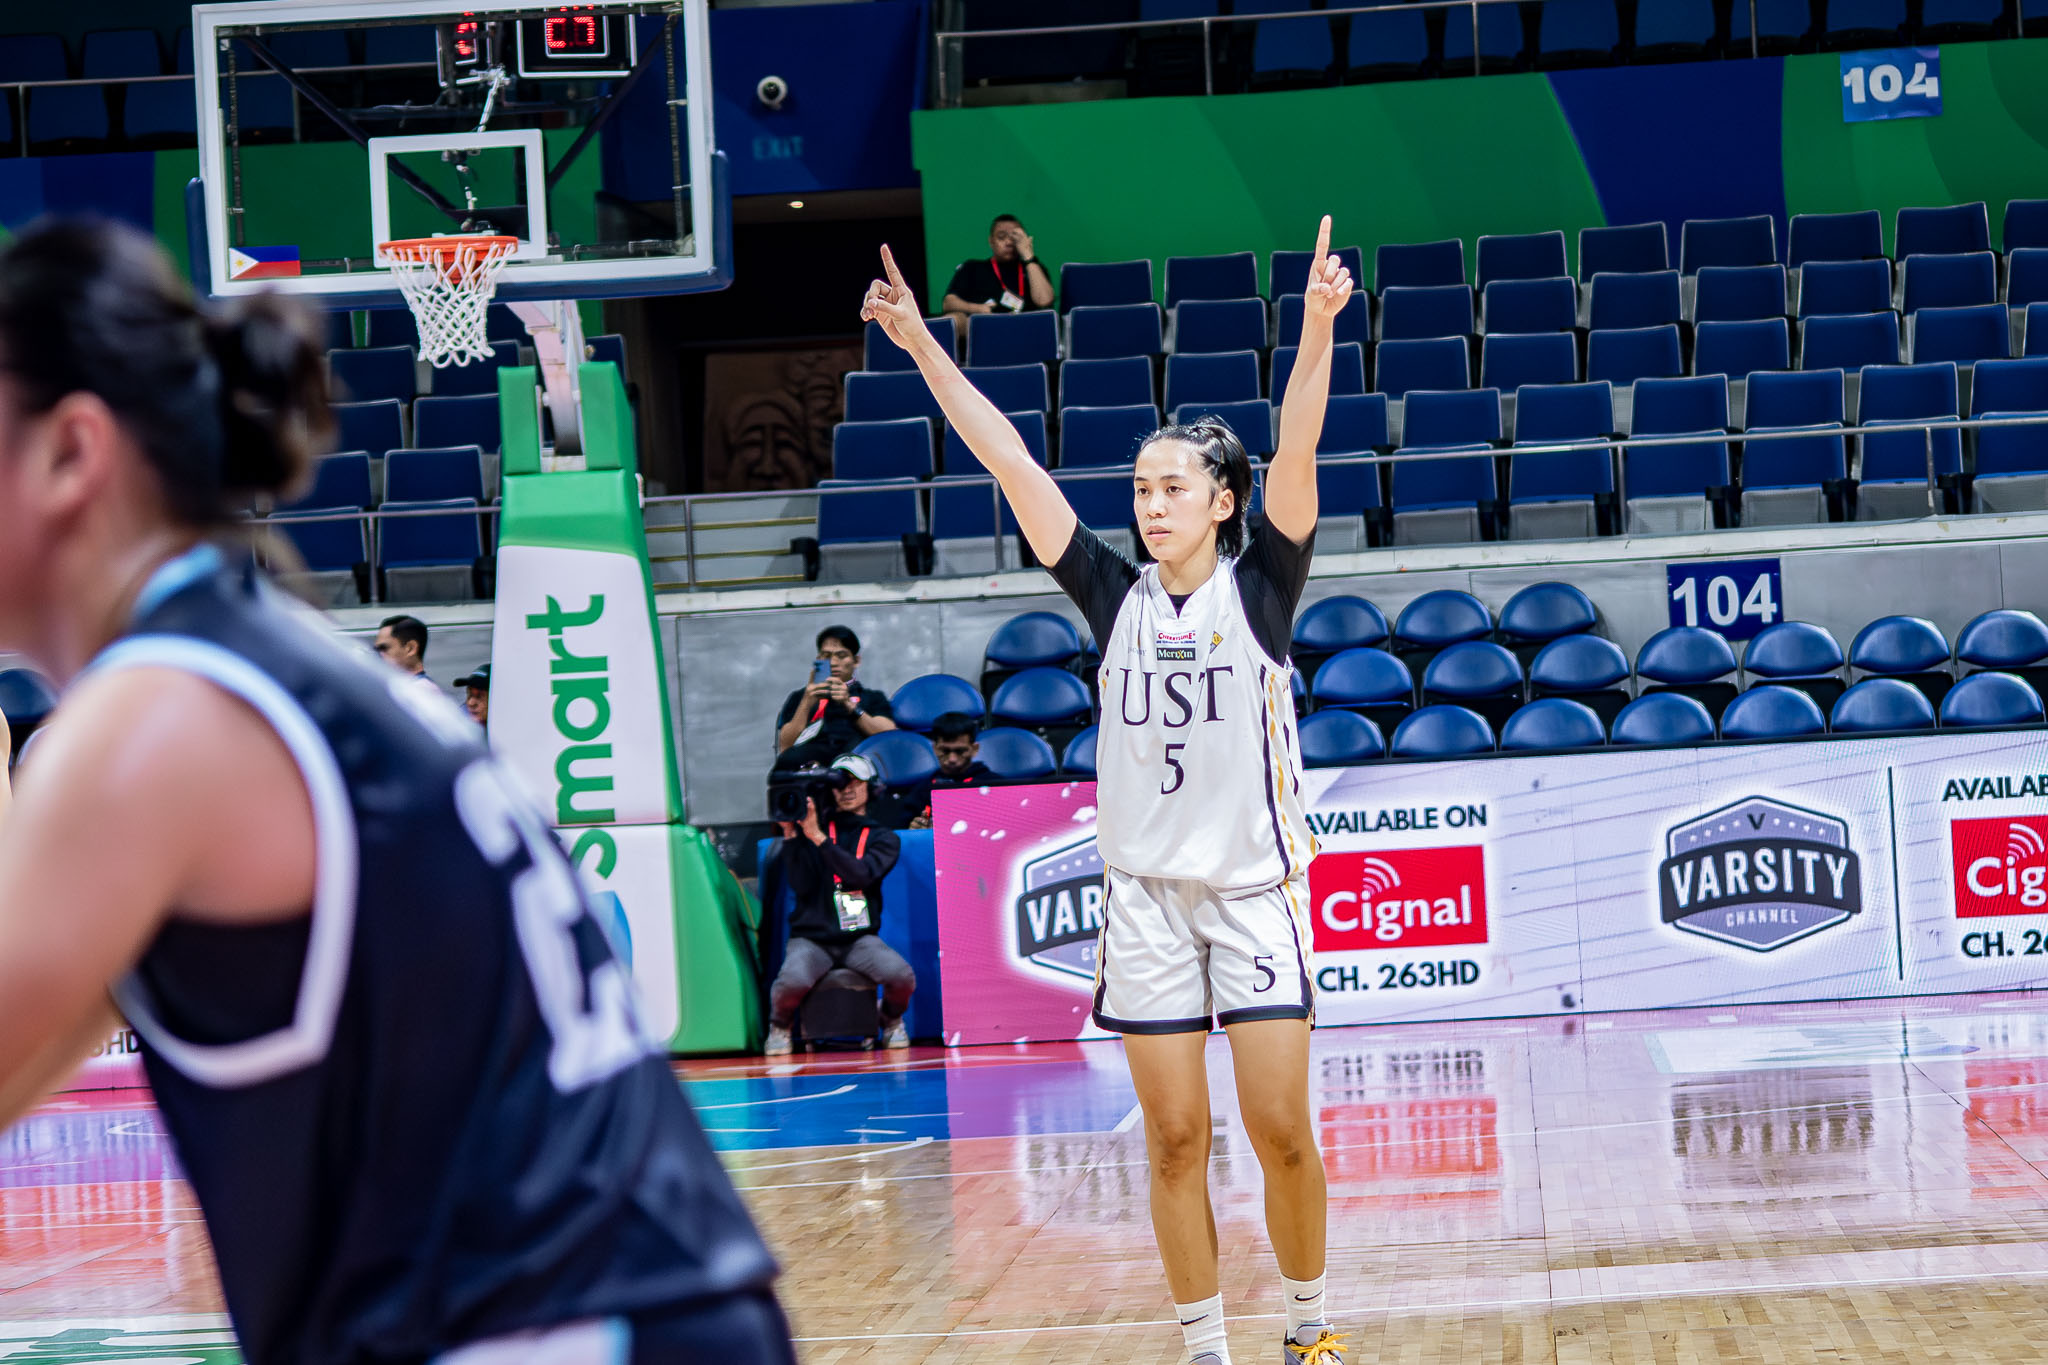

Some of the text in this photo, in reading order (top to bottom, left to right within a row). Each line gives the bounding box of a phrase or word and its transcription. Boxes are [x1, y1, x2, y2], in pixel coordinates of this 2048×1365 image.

[1843, 62, 1939, 104] 104
[752, 136, 803, 159] EXIT
[1673, 573, 1777, 627] 104
[1119, 665, 1233, 728] UST
[525, 593, 618, 880] smart
[1161, 743, 1186, 795] 5
[1445, 804, 1487, 828] ON
[1669, 847, 1849, 909] VARSITY
[1321, 884, 1472, 941] Cignal
[1725, 908, 1799, 928] CHANNEL
[1961, 931, 2014, 958] CH.
[1253, 955, 1276, 993] 5
[1316, 959, 1480, 992] CH. 263HD
